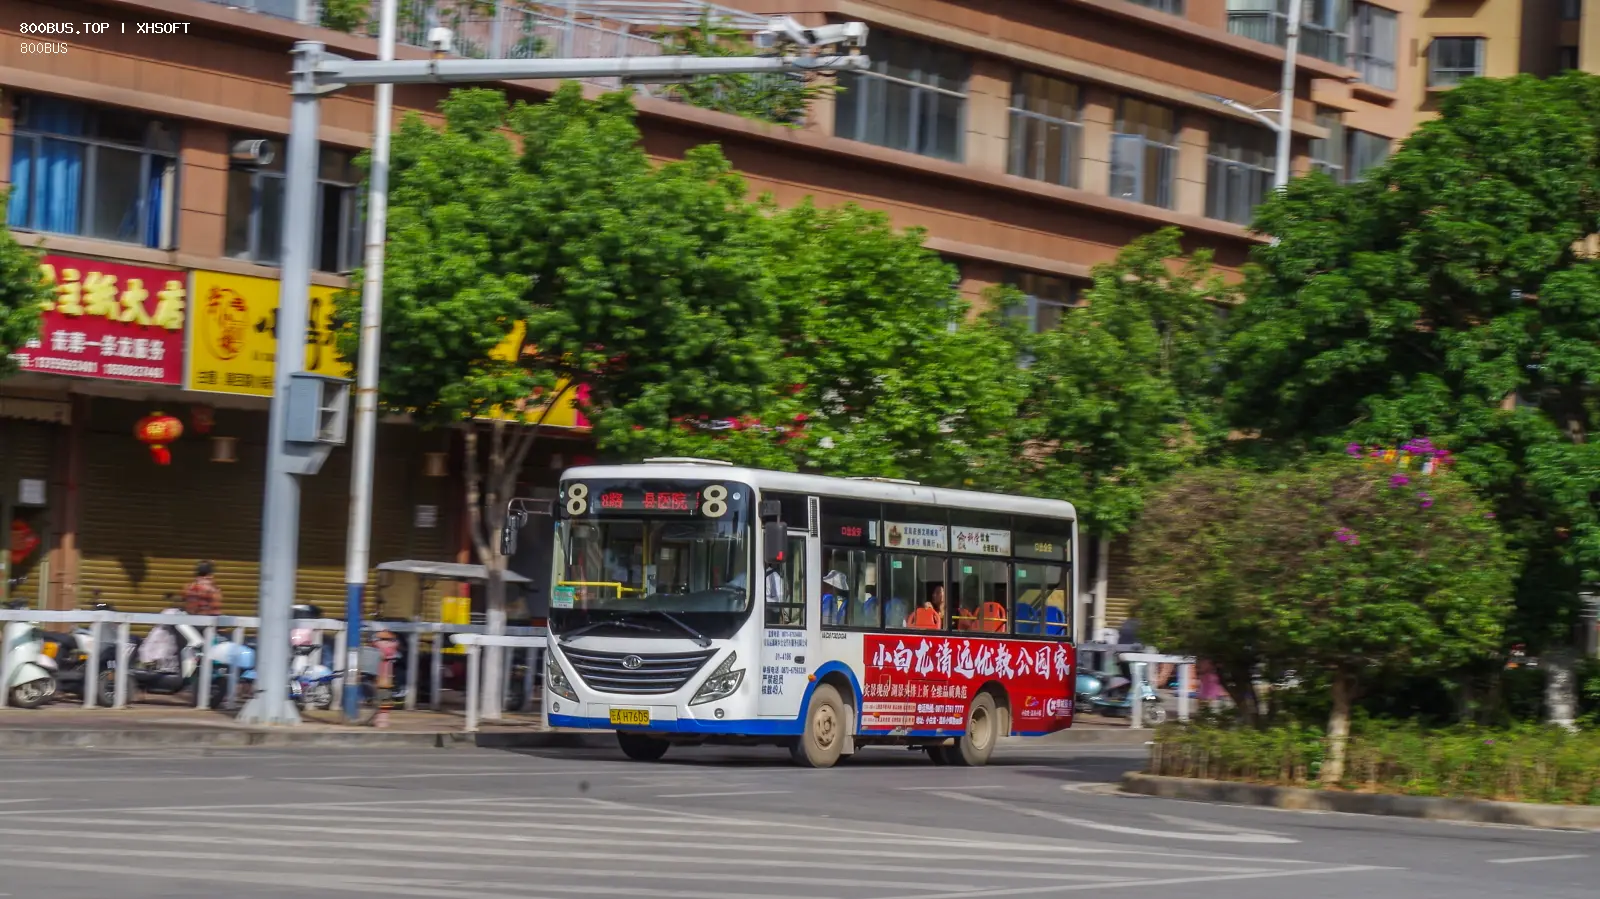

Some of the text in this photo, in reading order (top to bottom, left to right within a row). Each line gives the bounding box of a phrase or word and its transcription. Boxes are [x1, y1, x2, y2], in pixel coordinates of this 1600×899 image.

[566, 483, 588, 515] 8
[601, 491, 688, 510] 8路 县医院
[702, 484, 728, 518] 8
